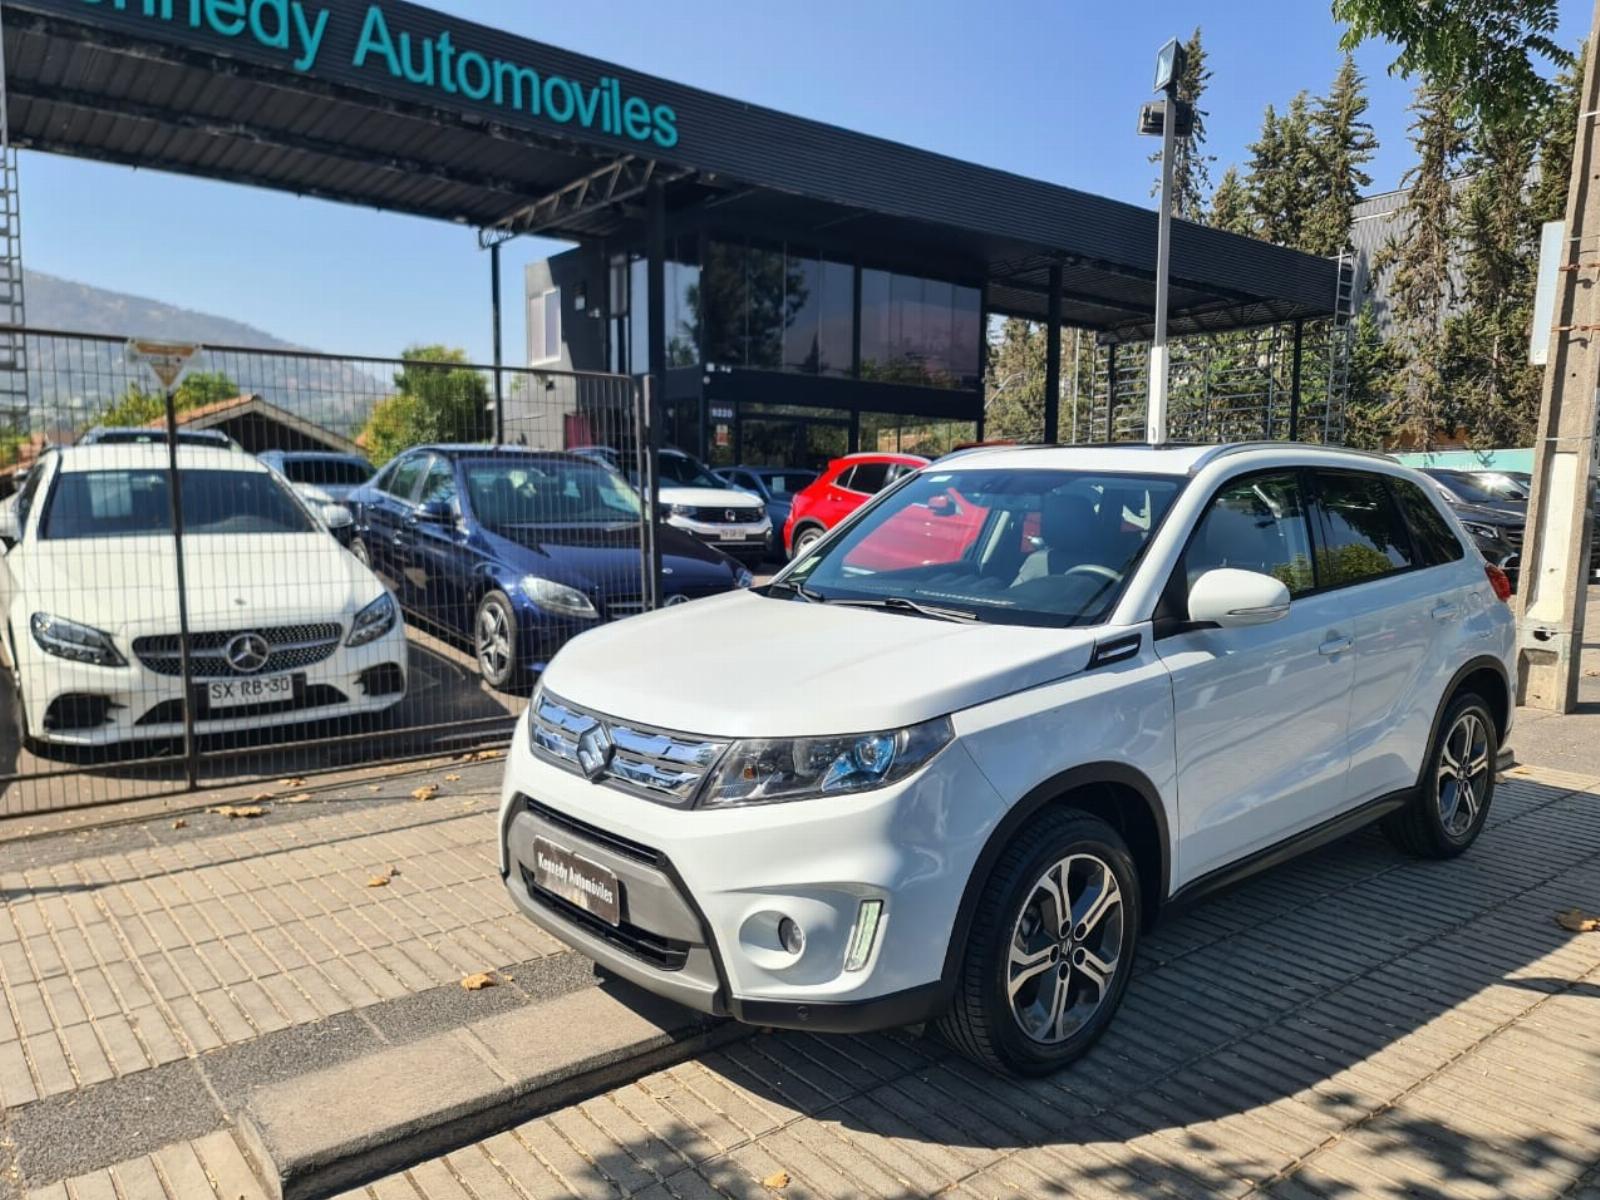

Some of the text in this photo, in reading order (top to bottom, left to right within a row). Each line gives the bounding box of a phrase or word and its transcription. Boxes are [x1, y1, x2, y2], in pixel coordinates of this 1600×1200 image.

[84, 0, 679, 147] edy Automoviles
[537, 851, 568, 885] Kennedy
